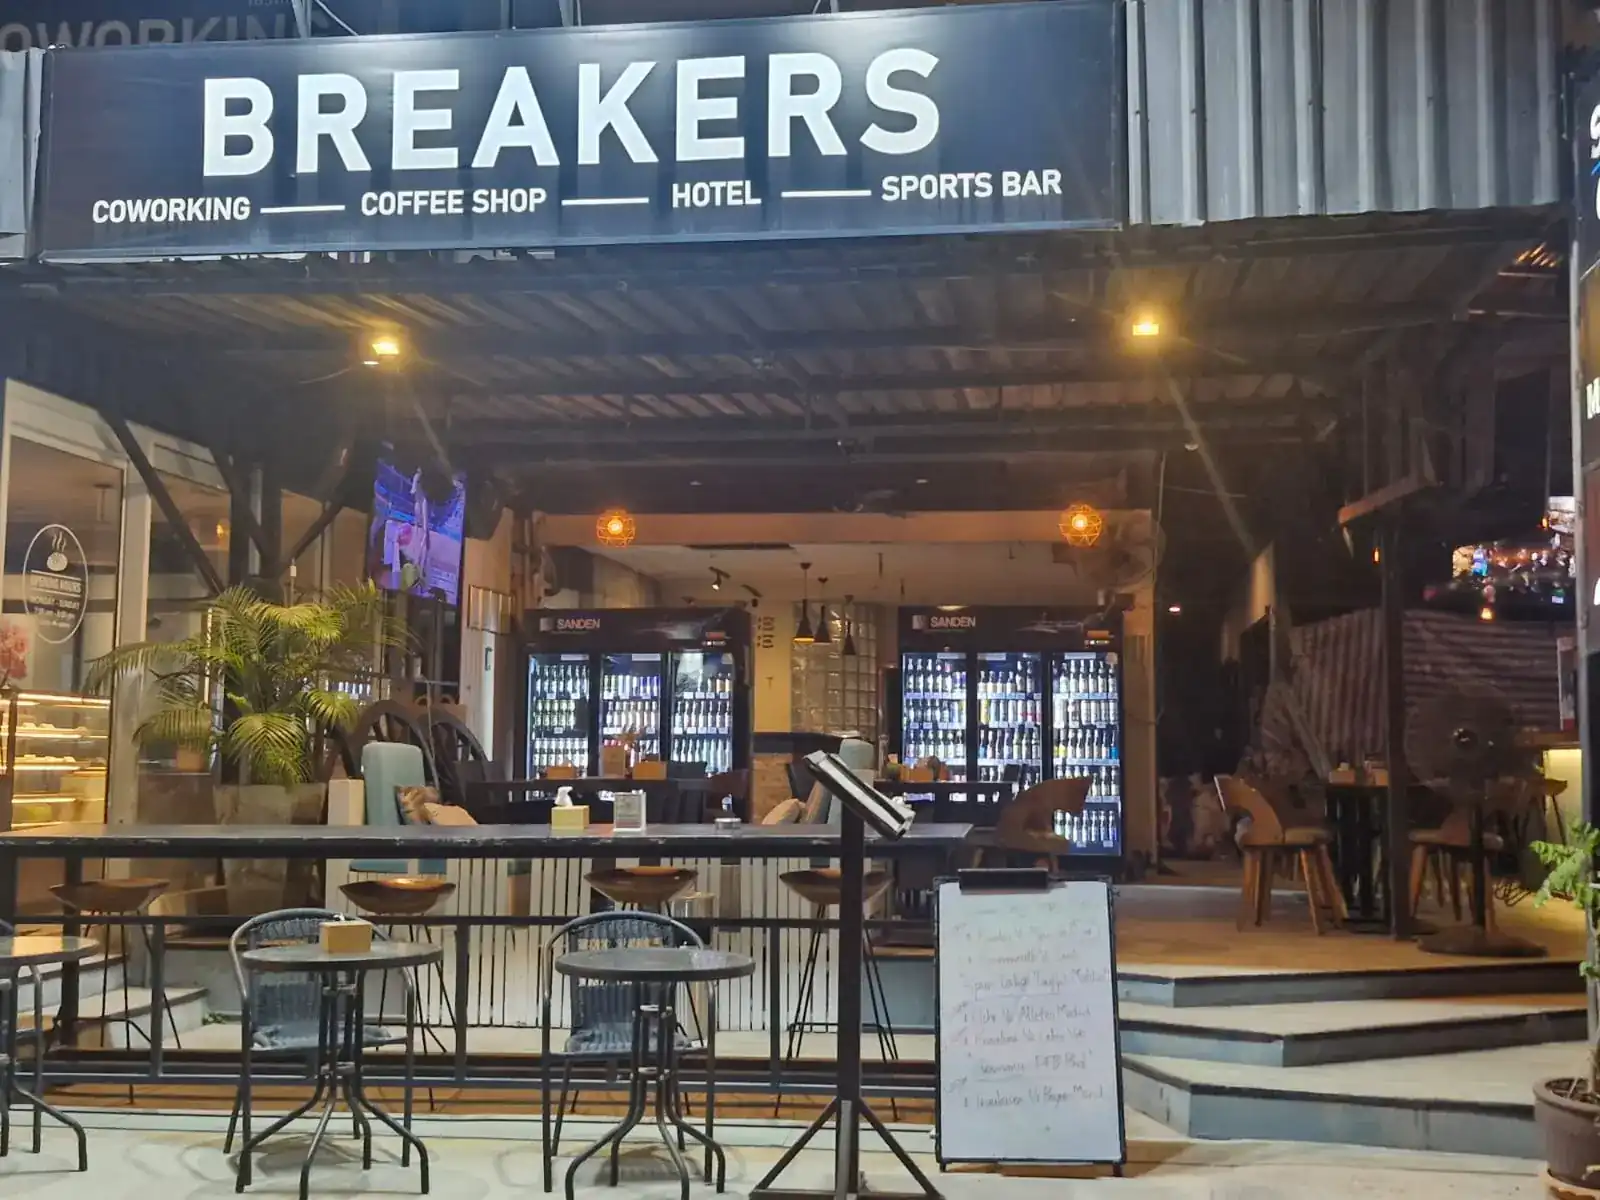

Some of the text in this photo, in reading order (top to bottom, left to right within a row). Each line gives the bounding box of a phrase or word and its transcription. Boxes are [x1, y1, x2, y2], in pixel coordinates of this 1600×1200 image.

[203, 48, 940, 177] BREAKERS
[92, 169, 1063, 224] COWORKING COFFEE SHOP HOTEL SPORTS BAR
[557, 618, 601, 629] SANDEN
[930, 616, 976, 628] SANDEN
